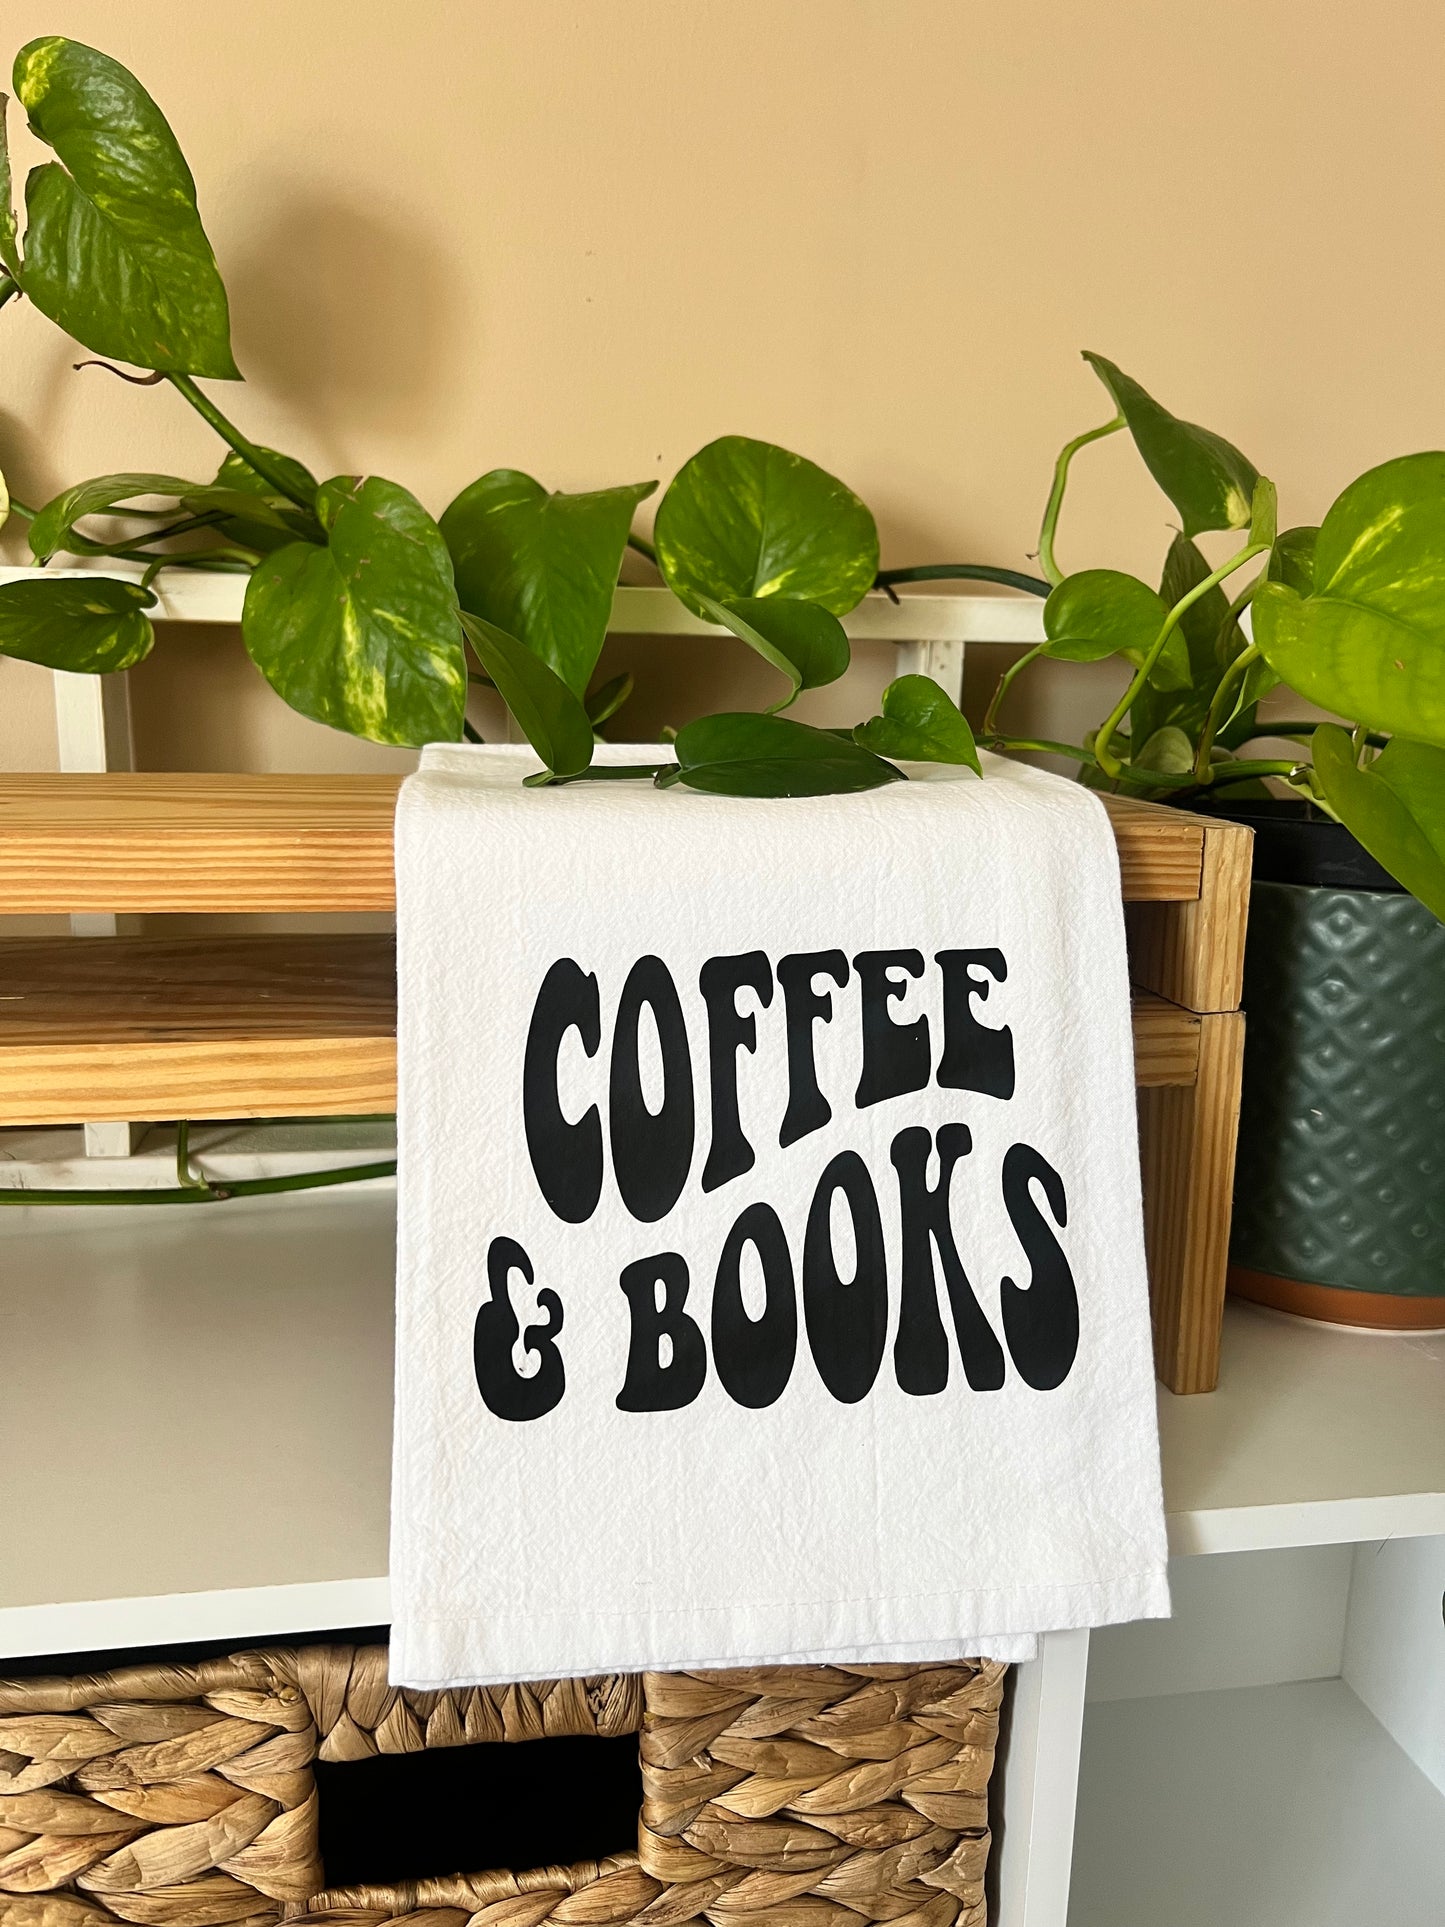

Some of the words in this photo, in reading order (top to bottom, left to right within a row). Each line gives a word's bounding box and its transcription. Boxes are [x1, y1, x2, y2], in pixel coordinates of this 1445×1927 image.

[523, 948, 1016, 1224] COFFEE
[474, 1236, 566, 1421] &
[616, 1123, 1080, 1412] BOOKS
